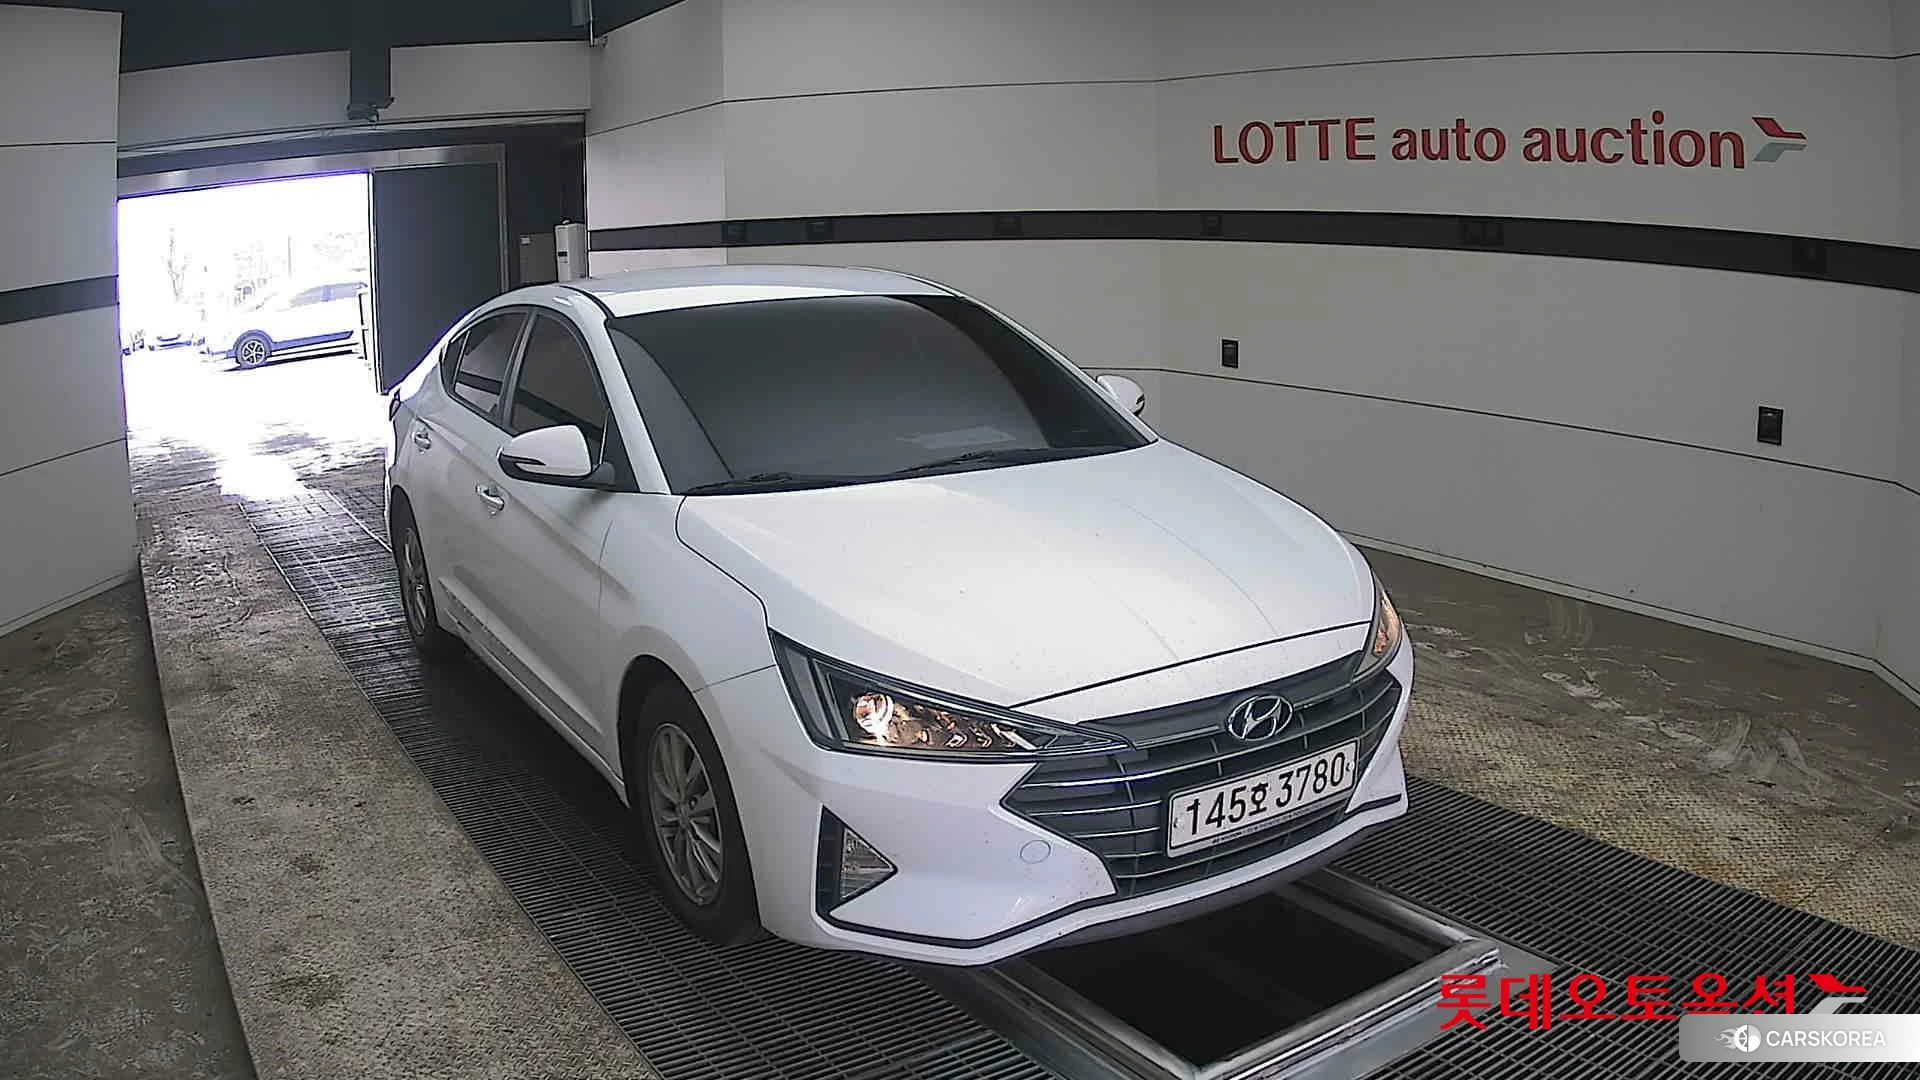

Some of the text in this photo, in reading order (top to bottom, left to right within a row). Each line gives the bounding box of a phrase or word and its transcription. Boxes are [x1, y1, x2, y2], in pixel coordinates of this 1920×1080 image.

[1213, 110, 1744, 169] LOTTE auto auction
[1275, 752, 1345, 808] 3780
